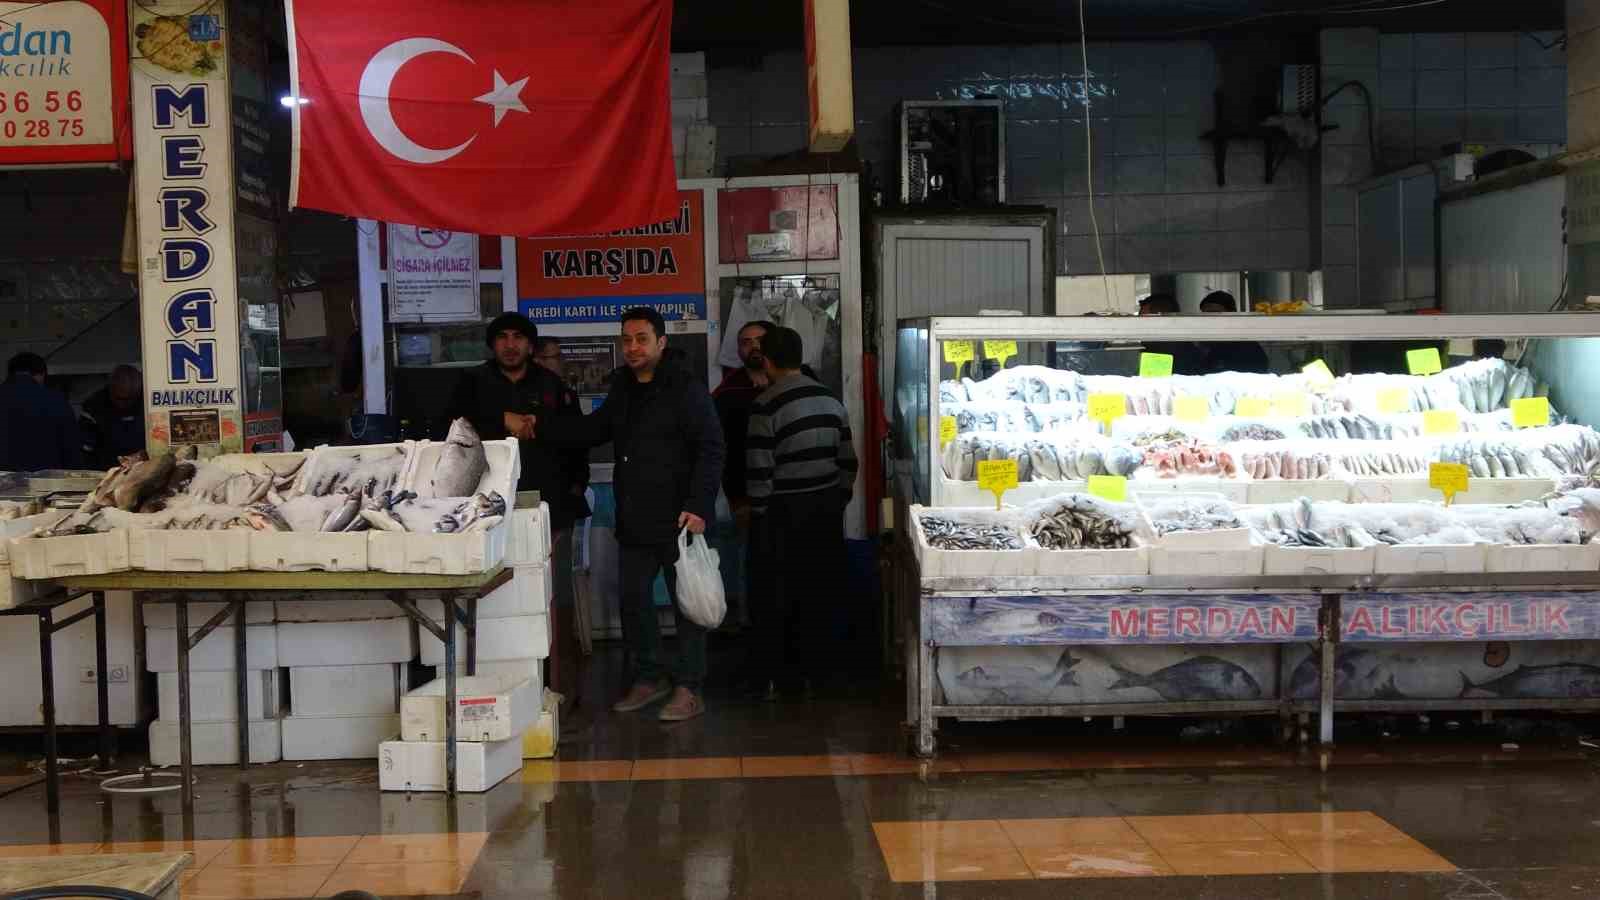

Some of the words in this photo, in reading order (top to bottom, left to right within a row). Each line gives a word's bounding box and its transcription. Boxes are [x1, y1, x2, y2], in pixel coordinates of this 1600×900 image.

[45, 90, 82, 112] 56
[24, 119, 50, 138] 28
[57, 118, 84, 137] 75
[151, 82, 217, 384] MERDAN
[543, 246, 679, 284] KARŞIDA
[528, 304, 561, 318] KREDİ
[564, 305, 596, 317] KARTI
[152, 389, 233, 408] BALIKÇILIK
[1109, 606, 1297, 638] MERDAN
[1317, 602, 1569, 638] ALIKÇILIK
